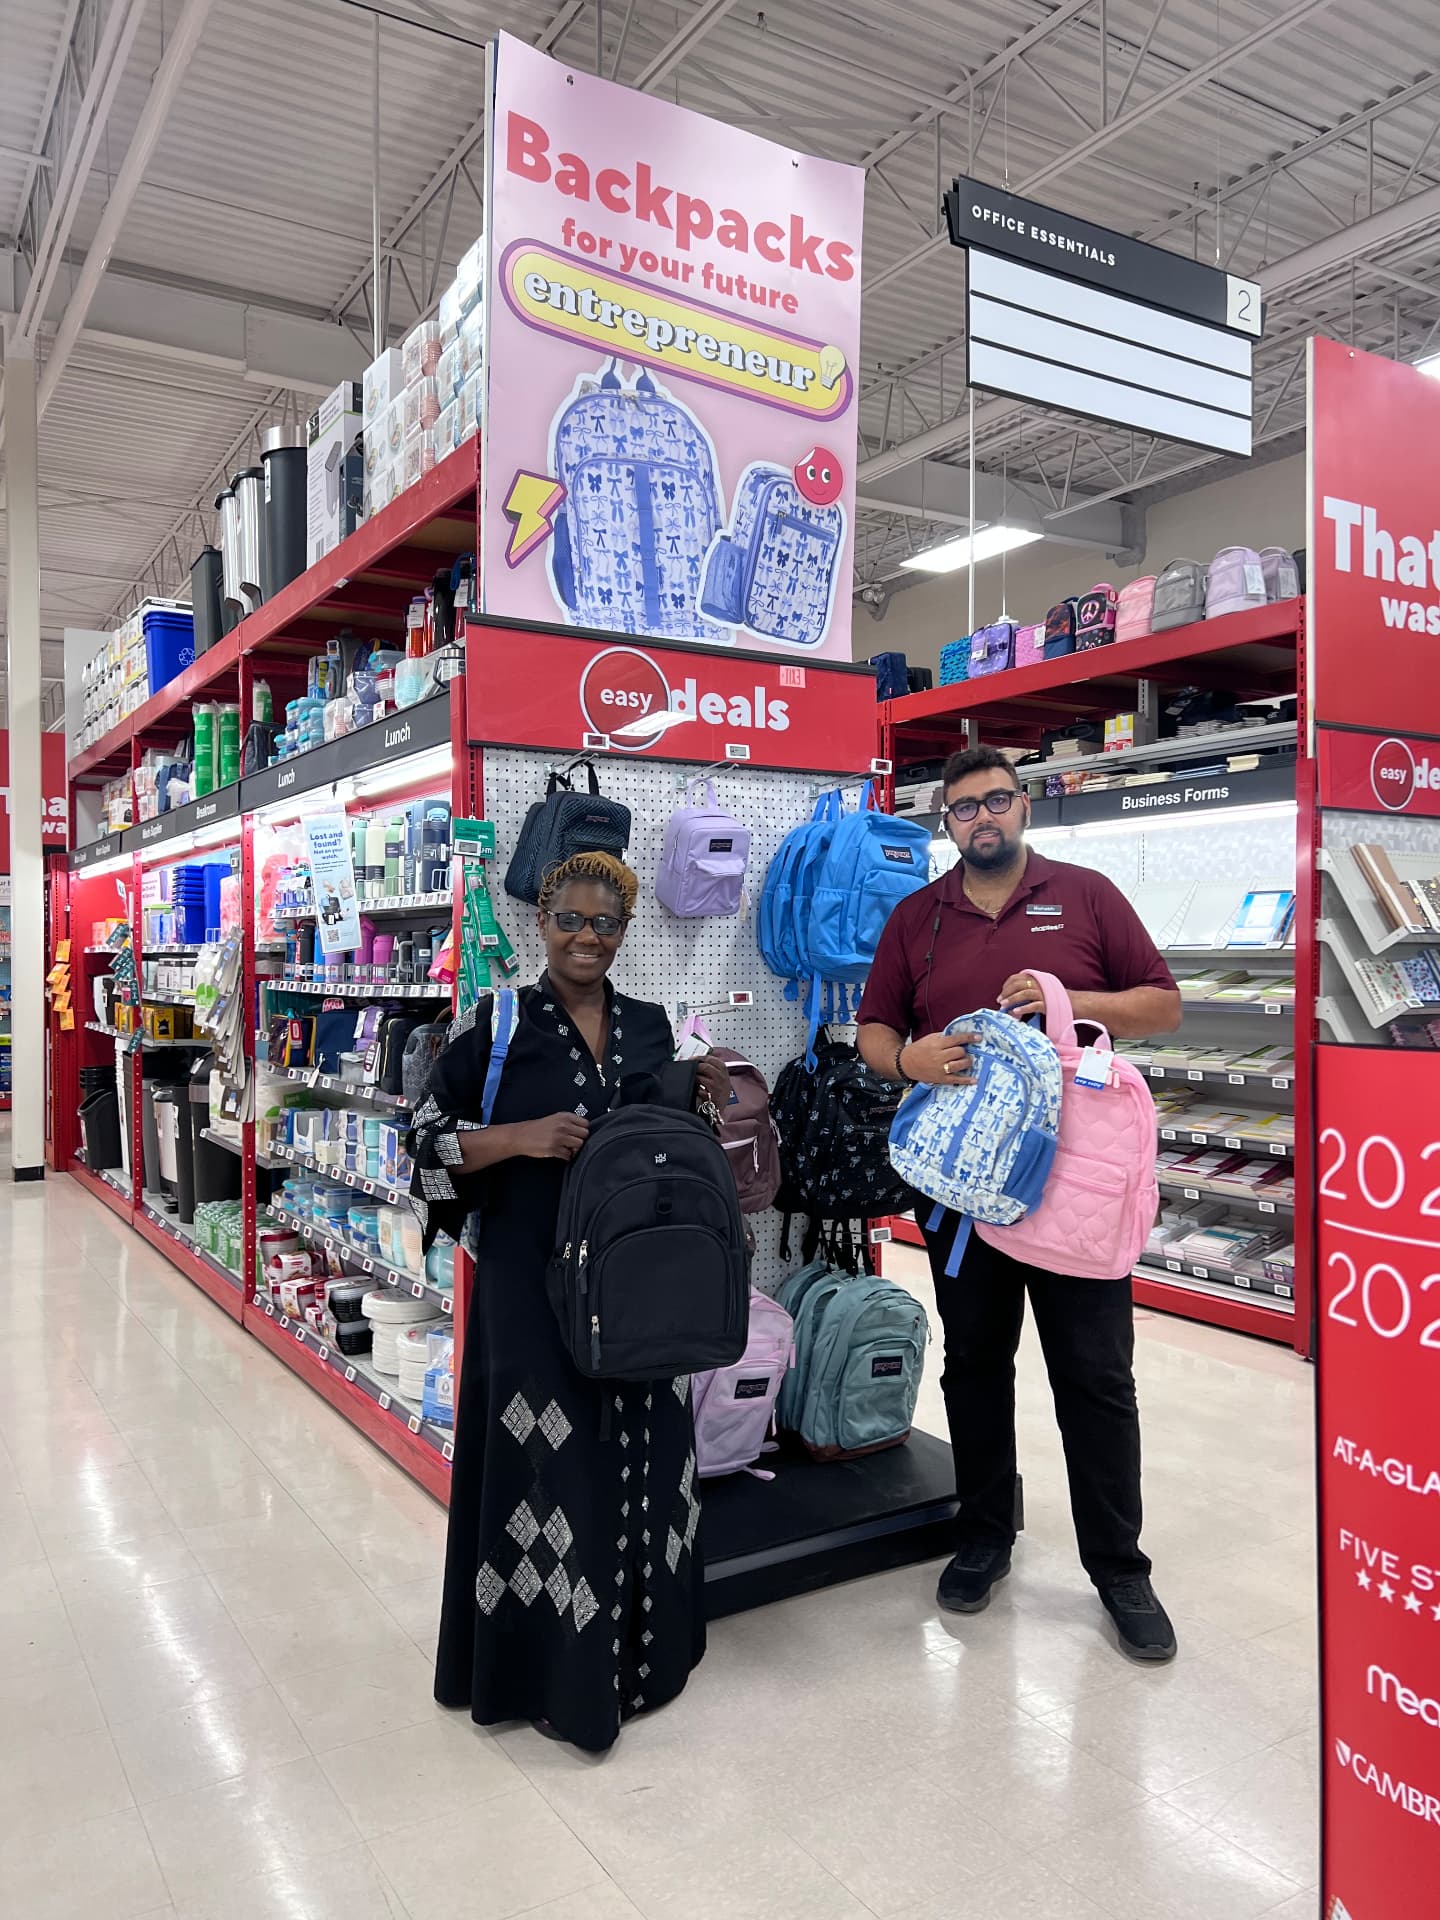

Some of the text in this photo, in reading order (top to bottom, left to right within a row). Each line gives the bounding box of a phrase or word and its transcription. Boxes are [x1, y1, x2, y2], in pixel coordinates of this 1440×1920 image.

[507, 110, 854, 281] Backpacks
[971, 205, 1116, 266] OFFICE ESSENTIALS
[562, 218, 799, 314] for your future
[1238, 289, 1251, 321] 2
[524, 273, 815, 392] entrepreneur
[600, 687, 653, 714] easy
[671, 678, 790, 731] deals
[385, 721, 411, 748] Lunch
[278, 768, 295, 789] Lunch
[1381, 767, 1407, 785] easy
[1121, 786, 1230, 810] Business Forms
[328, 830, 343, 838] and
[1340, 1527, 1400, 1580] FIVE
